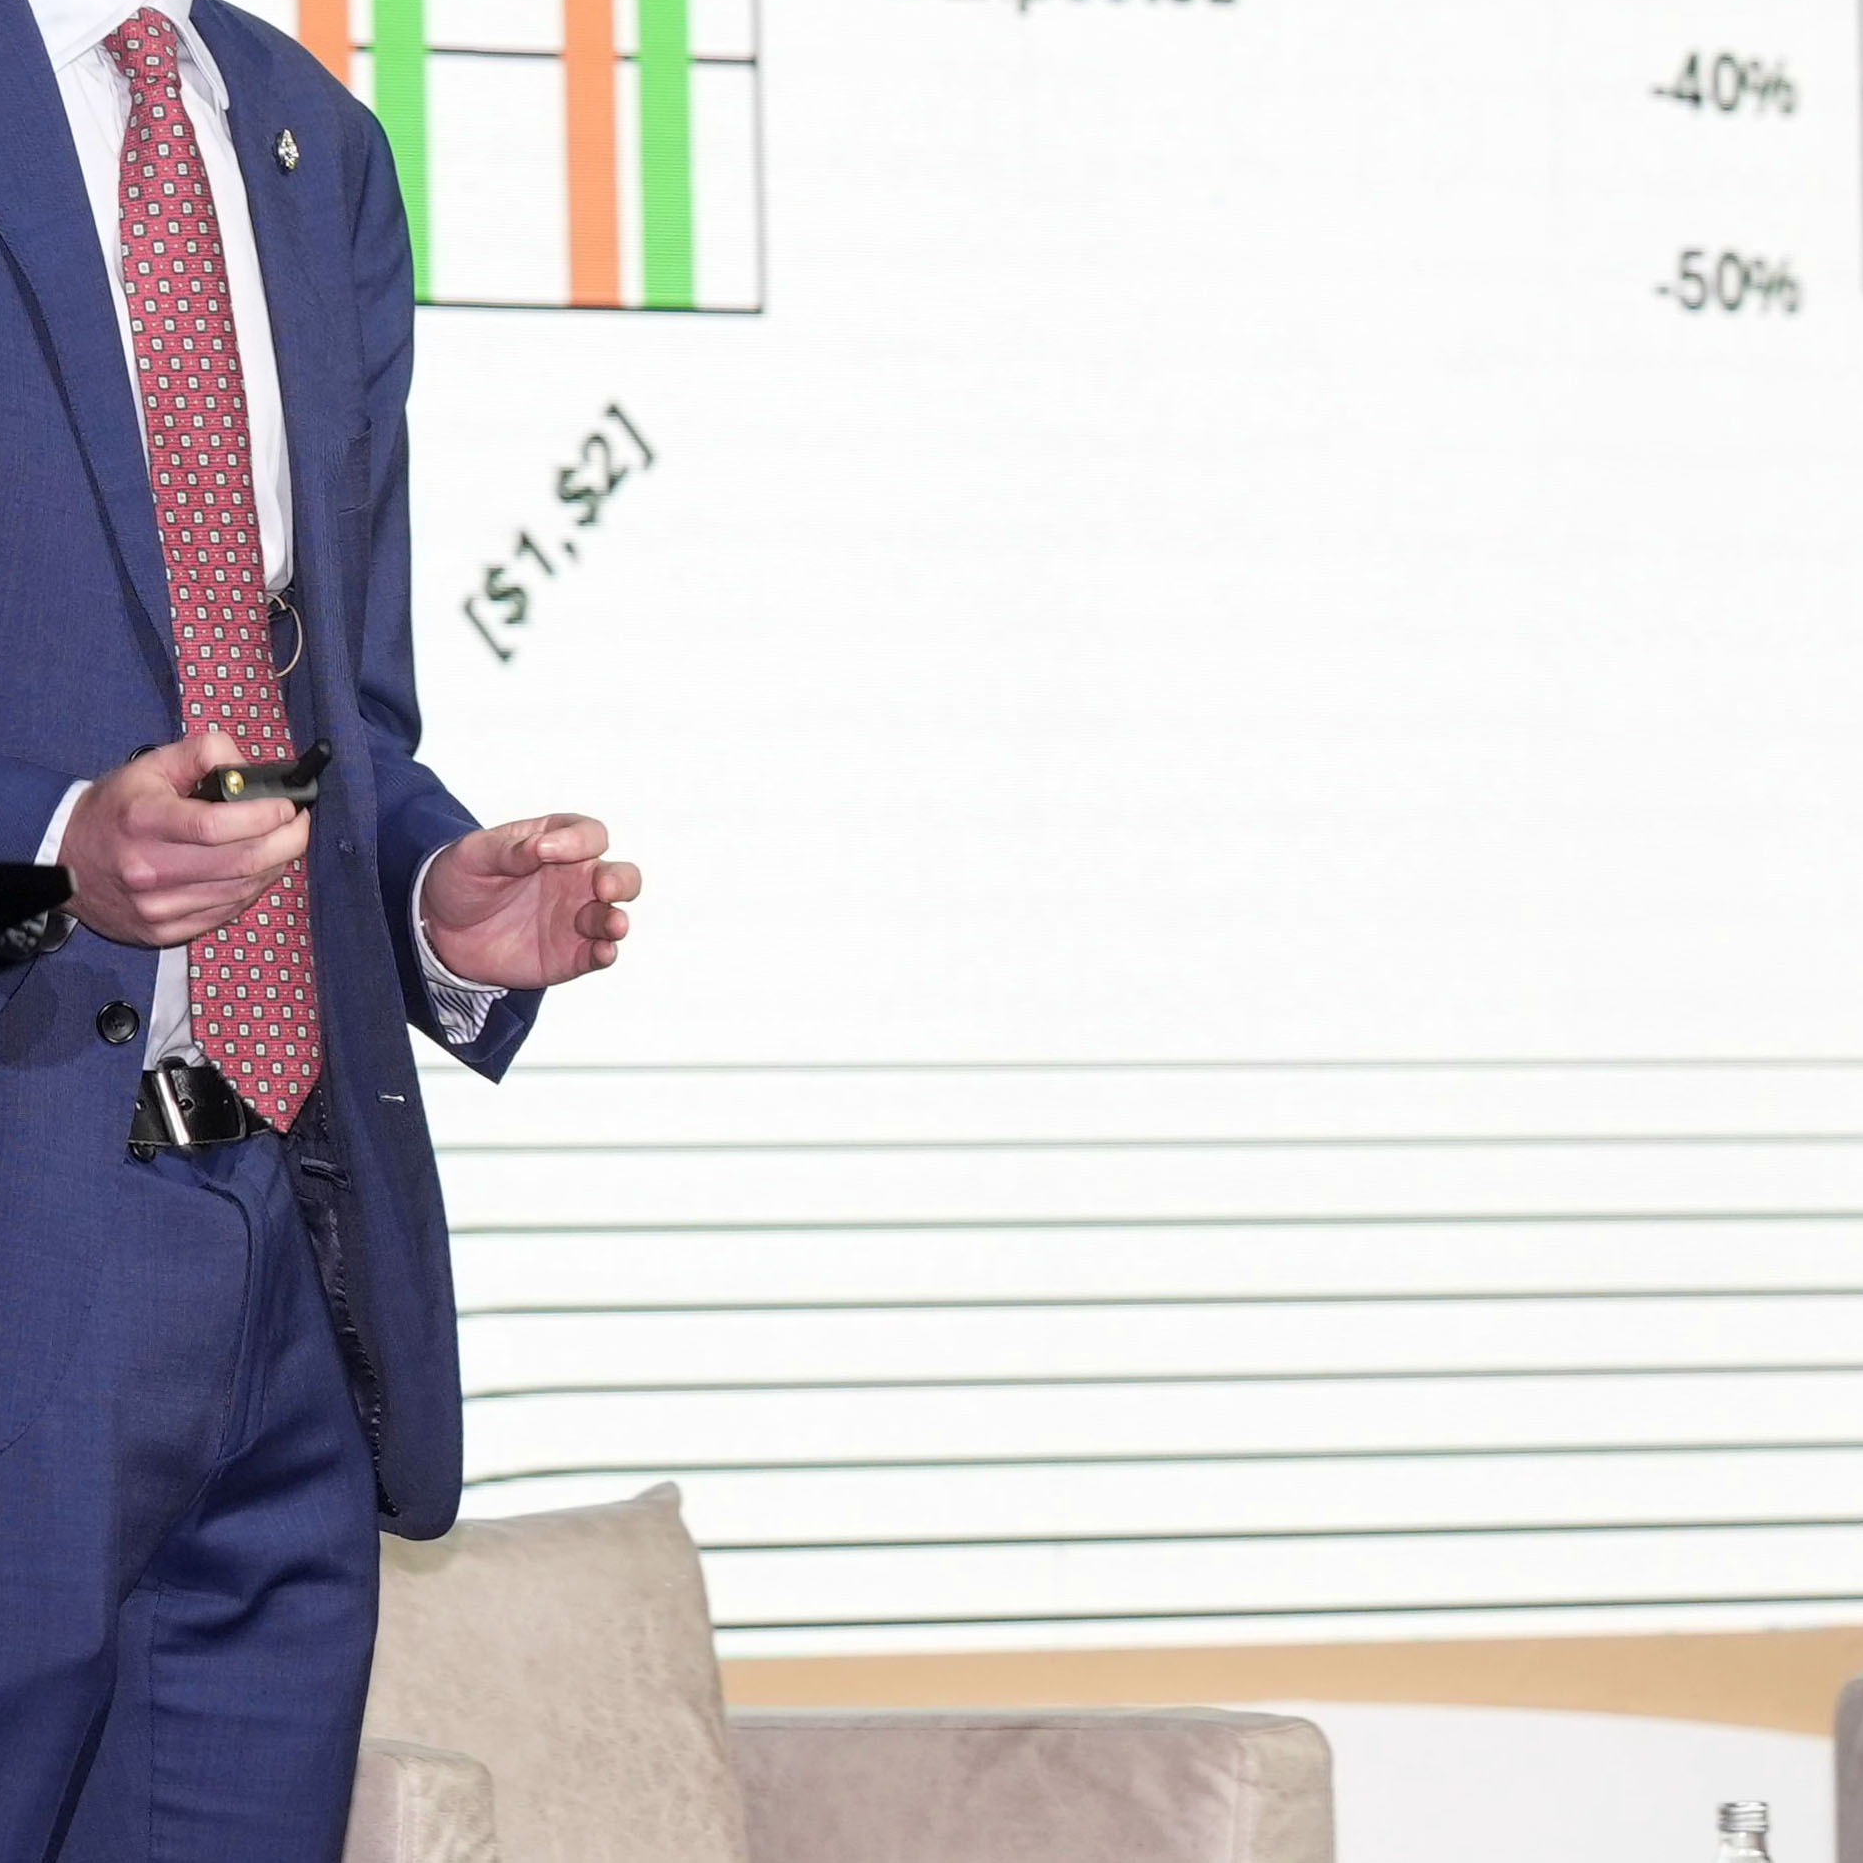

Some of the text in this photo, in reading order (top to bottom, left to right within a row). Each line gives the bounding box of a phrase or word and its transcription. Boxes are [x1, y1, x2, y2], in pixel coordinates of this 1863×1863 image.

[1653, 52, 1795, 115] -40%
[1657, 249, 1799, 314] -50%
[462, 403, 655, 664] [$1,$2]
